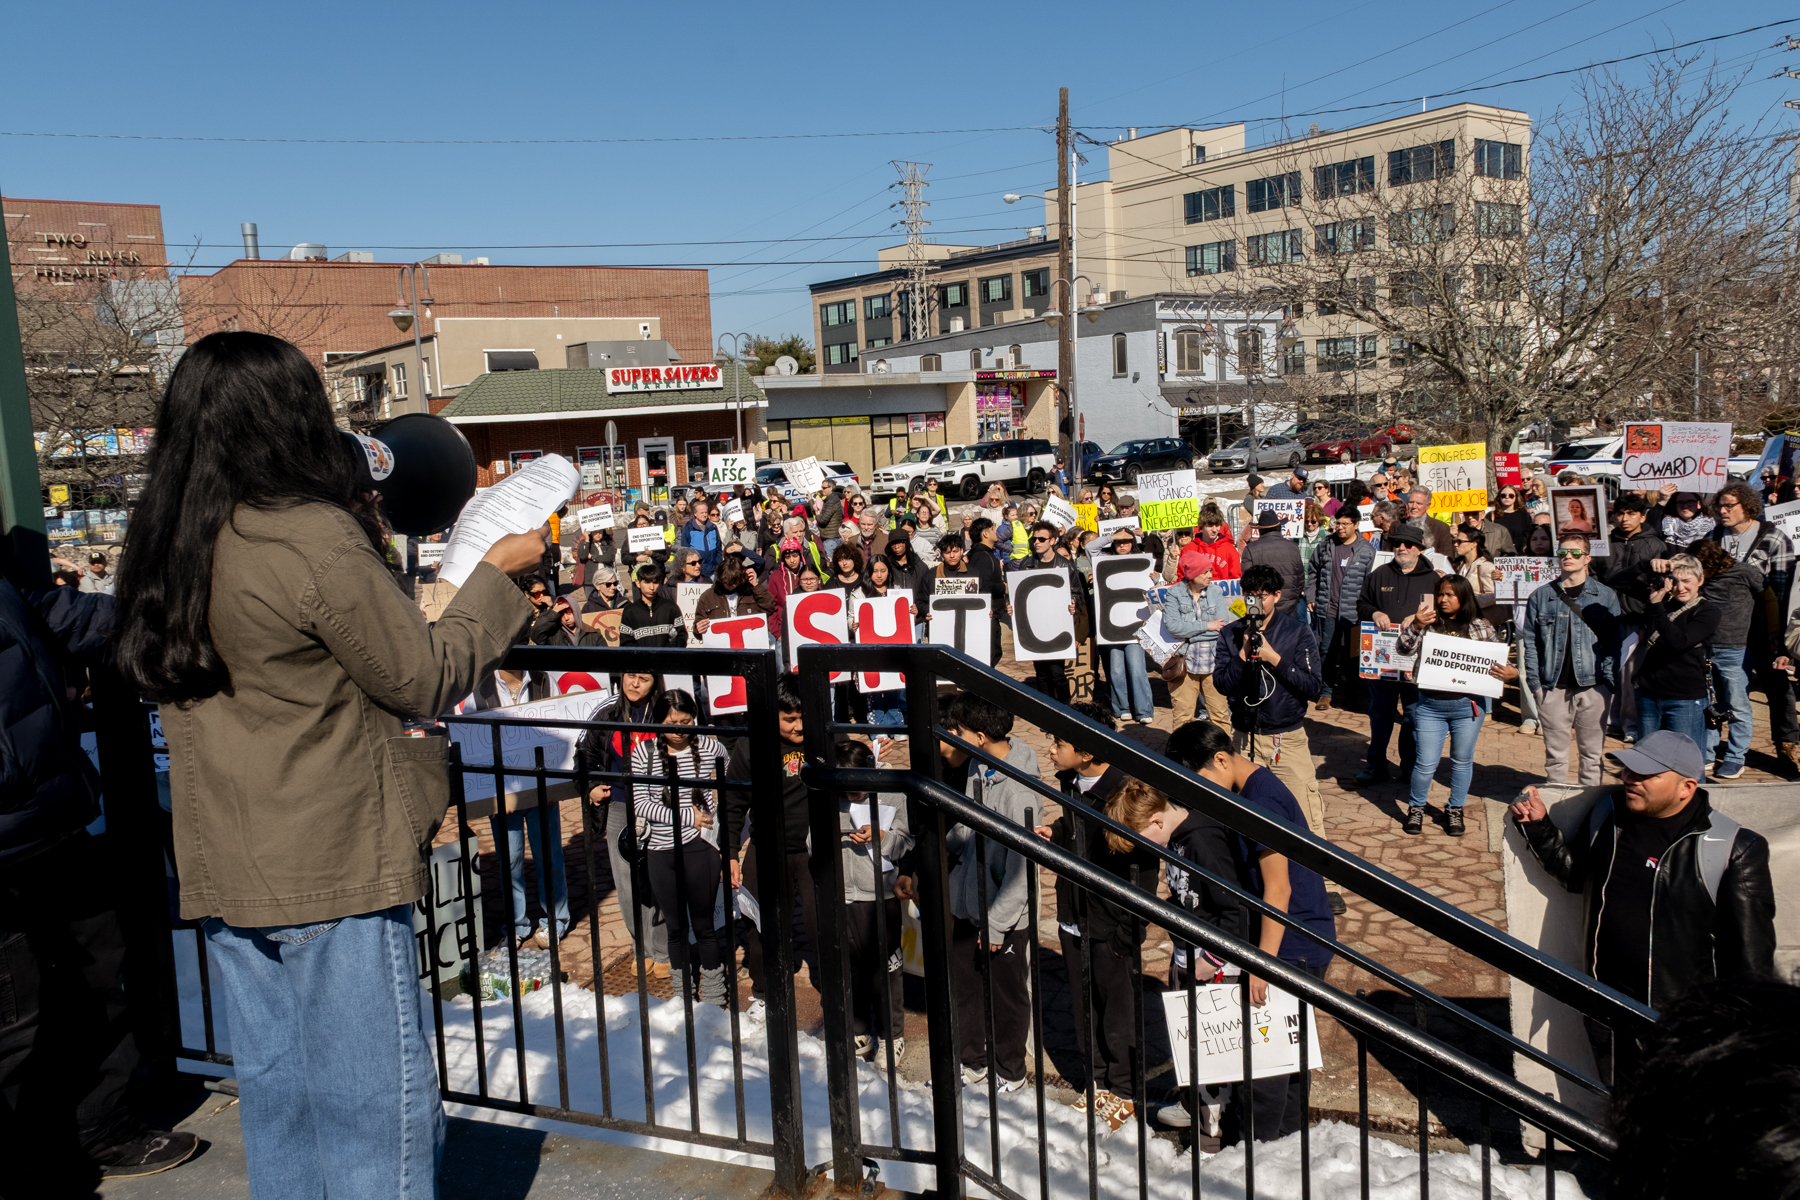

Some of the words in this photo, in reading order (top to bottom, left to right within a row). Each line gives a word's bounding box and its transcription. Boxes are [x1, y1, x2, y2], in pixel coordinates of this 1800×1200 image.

[43, 233, 85, 246] TWO
[34, 265, 113, 278] THEATE
[611, 368, 662, 384] SUPER
[663, 366, 719, 382] SAVERS
[632, 380, 701, 390] MARKETS
[722, 457, 738, 467] TY
[1420, 449, 1477, 464] CONGRESS
[784, 457, 818, 474] ABOLISH
[1429, 467, 1449, 479] GET
[1457, 466, 1467, 476] A
[711, 467, 747, 483] AFSC
[792, 472, 816, 489] ICE
[1139, 472, 1175, 490] ARREST
[1158, 485, 1193, 501] GANGS
[1438, 493, 1462, 508] YOUR
[1465, 493, 1487, 507] JOB
[1141, 503, 1160, 520] NOT
[1165, 501, 1197, 516] LEGAL
[1257, 502, 1293, 511] REDEEM
[1146, 513, 1198, 531] NEIGHBORS
[1277, 512, 1296, 523] SOUL
[1772, 513, 1784, 521] END
[52, 528, 78, 538] Modelo
[1495, 557, 1525, 565] MIGRATION
[1432, 648, 1449, 658] END
[1450, 652, 1497, 667] DETENTION
[1425, 656, 1443, 666] AND
[1444, 660, 1494, 676] DEPORTATIO
[1175, 987, 1227, 1019] ICE
[1252, 1010, 1272, 1026] IS
[1201, 1017, 1243, 1037] HUMA
